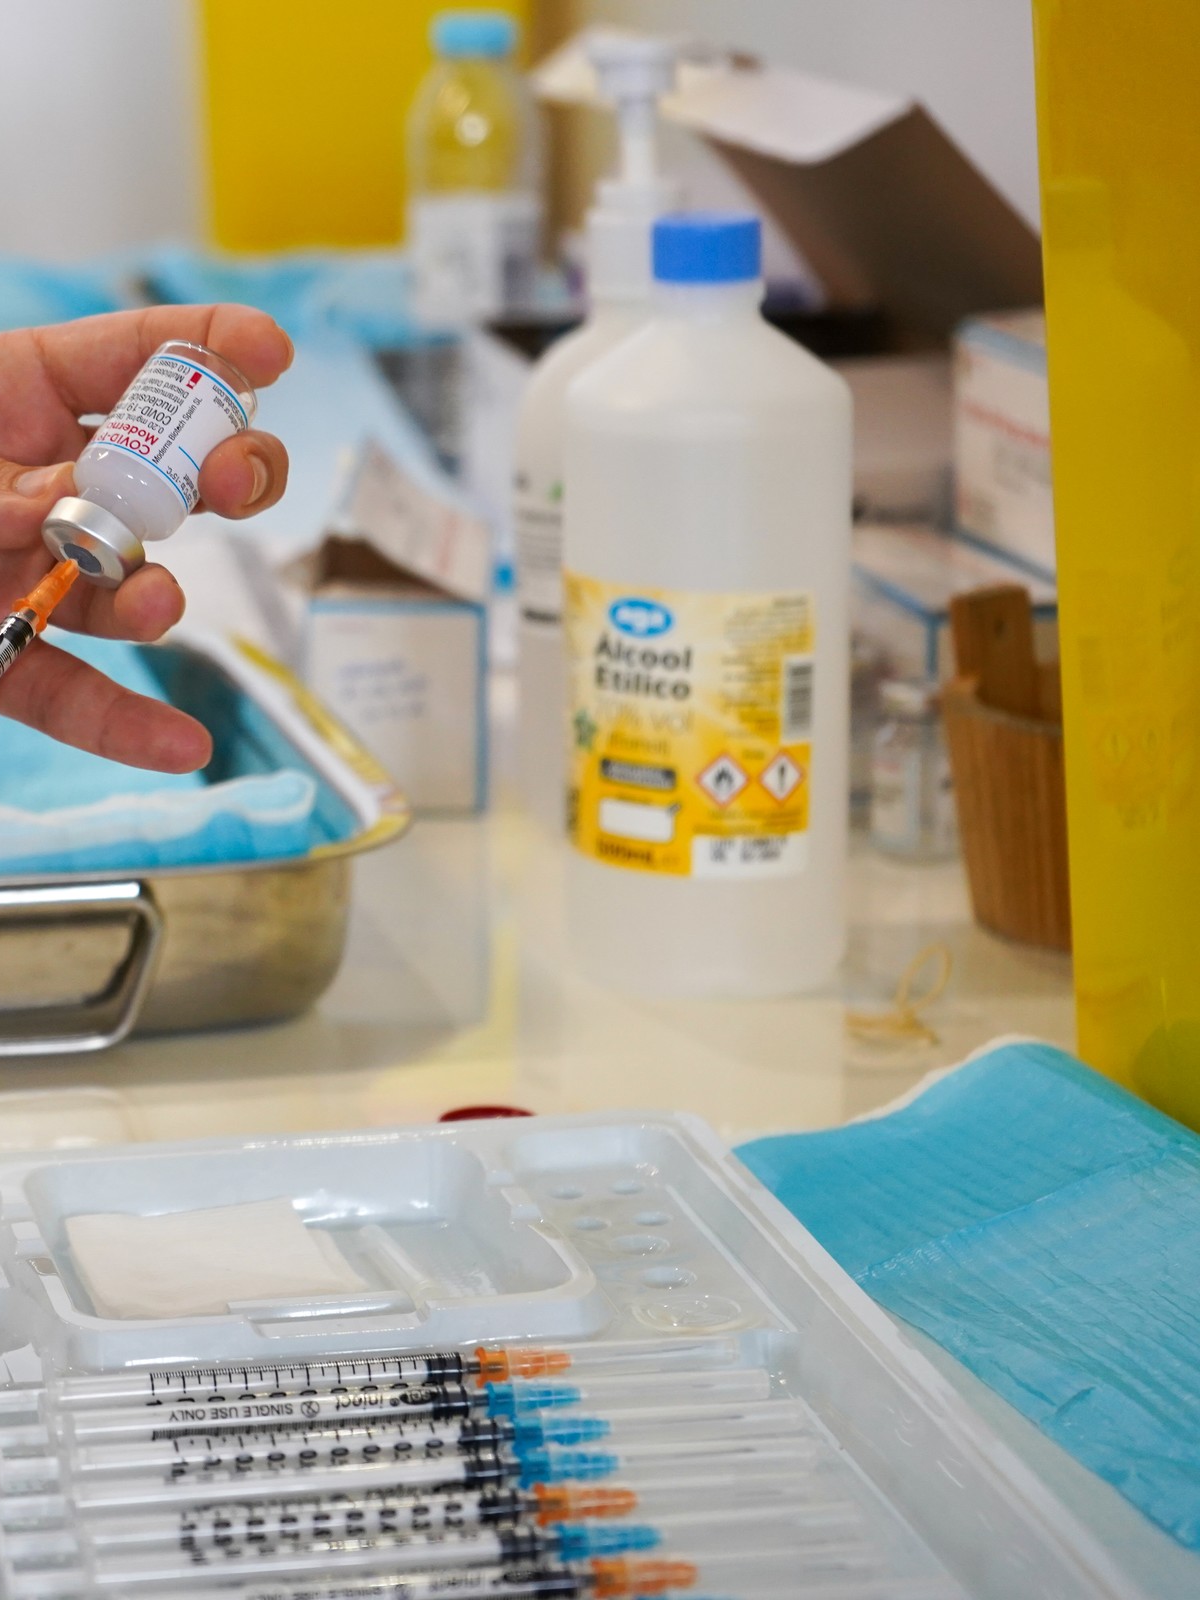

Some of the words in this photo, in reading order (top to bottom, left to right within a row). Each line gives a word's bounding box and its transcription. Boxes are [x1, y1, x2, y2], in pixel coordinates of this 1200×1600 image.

[176, 363, 190, 375] (10
[162, 381, 189, 399] Discard
[126, 402, 171, 425] COVID-19
[146, 420, 164, 434] 0.20
[151, 438, 172, 464] Moderna
[167, 418, 186, 441] Biotech
[181, 403, 198, 422] Spain
[192, 395, 203, 406] SL
[596, 633, 692, 671] Alcool
[595, 664, 691, 701] Etilico
[167, 1409, 205, 1421] ONLY
[209, 1406, 239, 1419] USE
[242, 1402, 293, 1417] SINGLE
